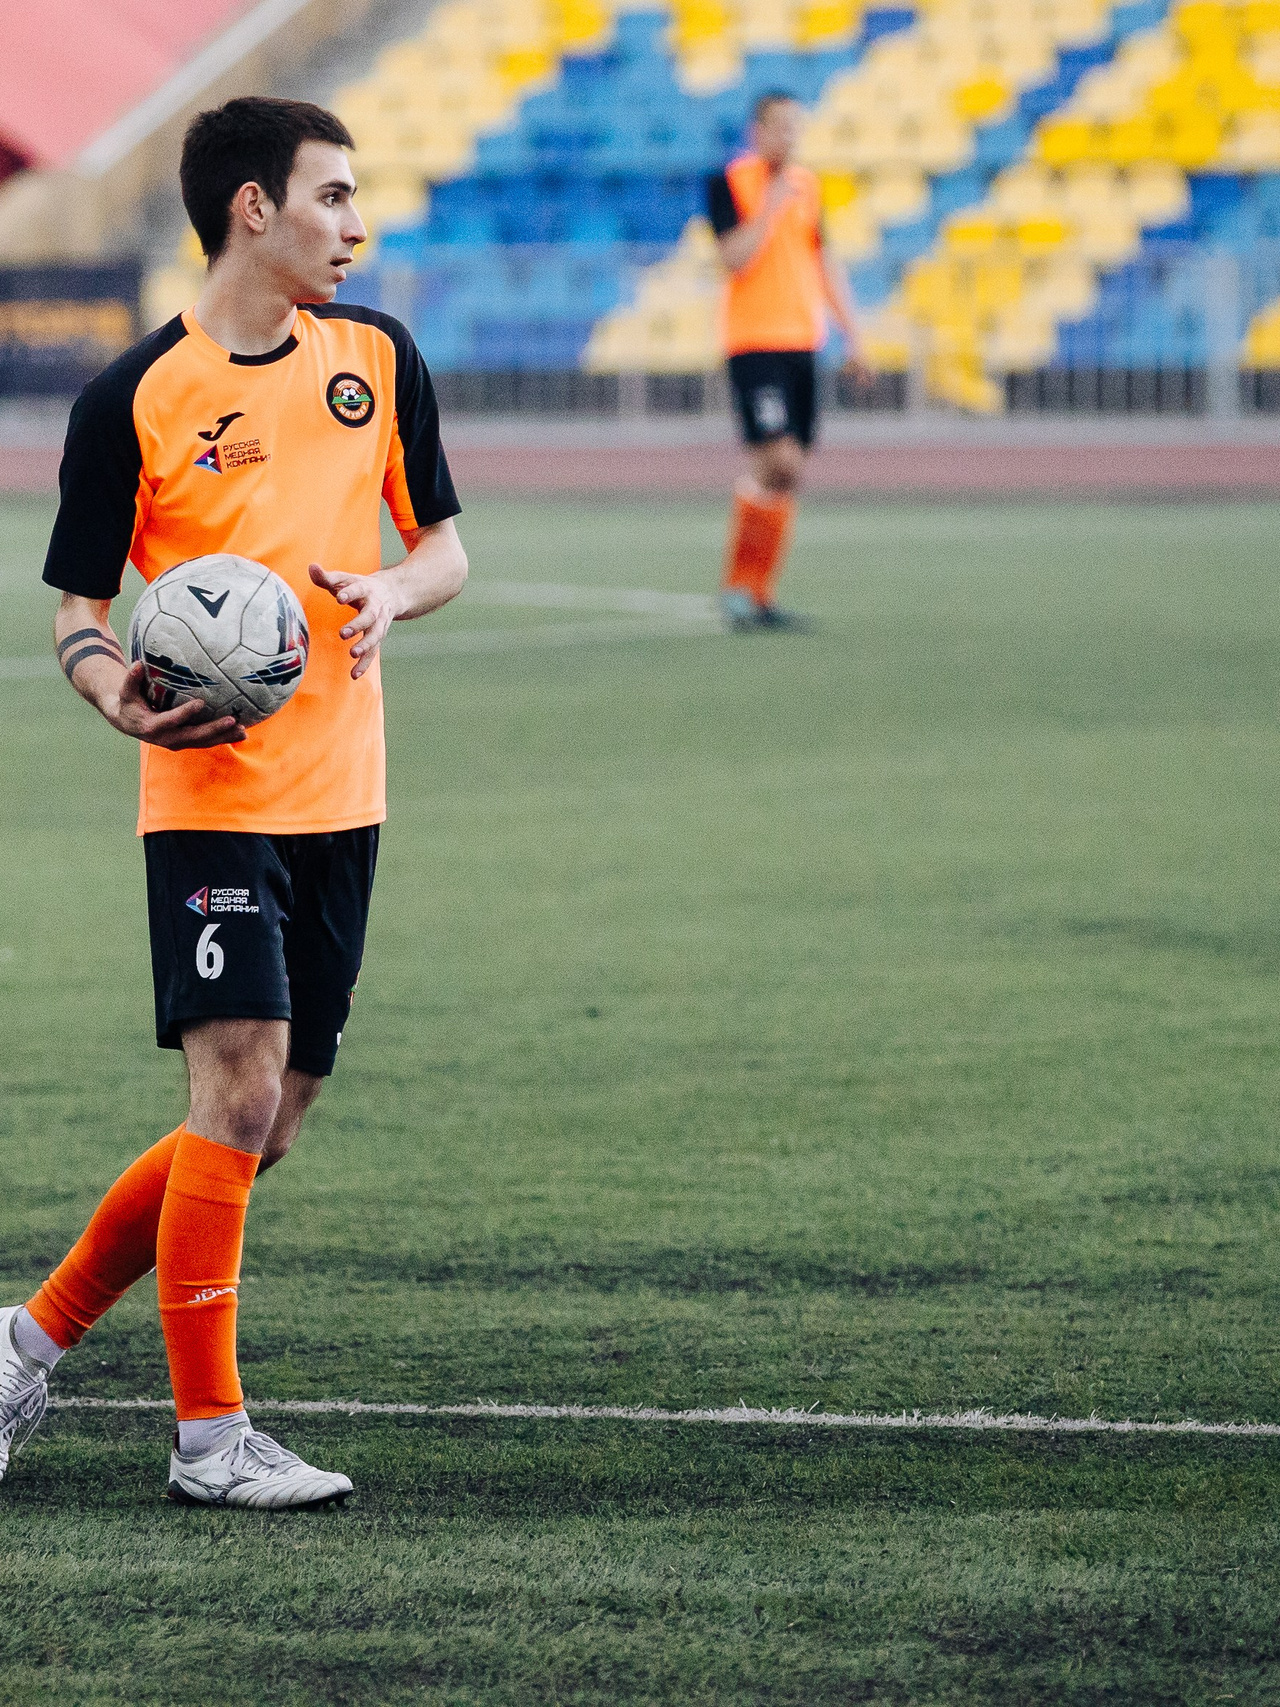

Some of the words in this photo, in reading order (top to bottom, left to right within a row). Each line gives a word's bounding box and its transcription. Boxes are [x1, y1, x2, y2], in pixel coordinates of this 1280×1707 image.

[223, 439, 261, 452] РУССКАЯ
[224, 447, 261, 460] МЕДНАЯ
[211, 888, 250, 896] РУССКАЯ
[210, 896, 248, 904] МЕДНАЯ
[210, 904, 260, 913] КОМПАНИЯ
[195, 923, 225, 980] 6
